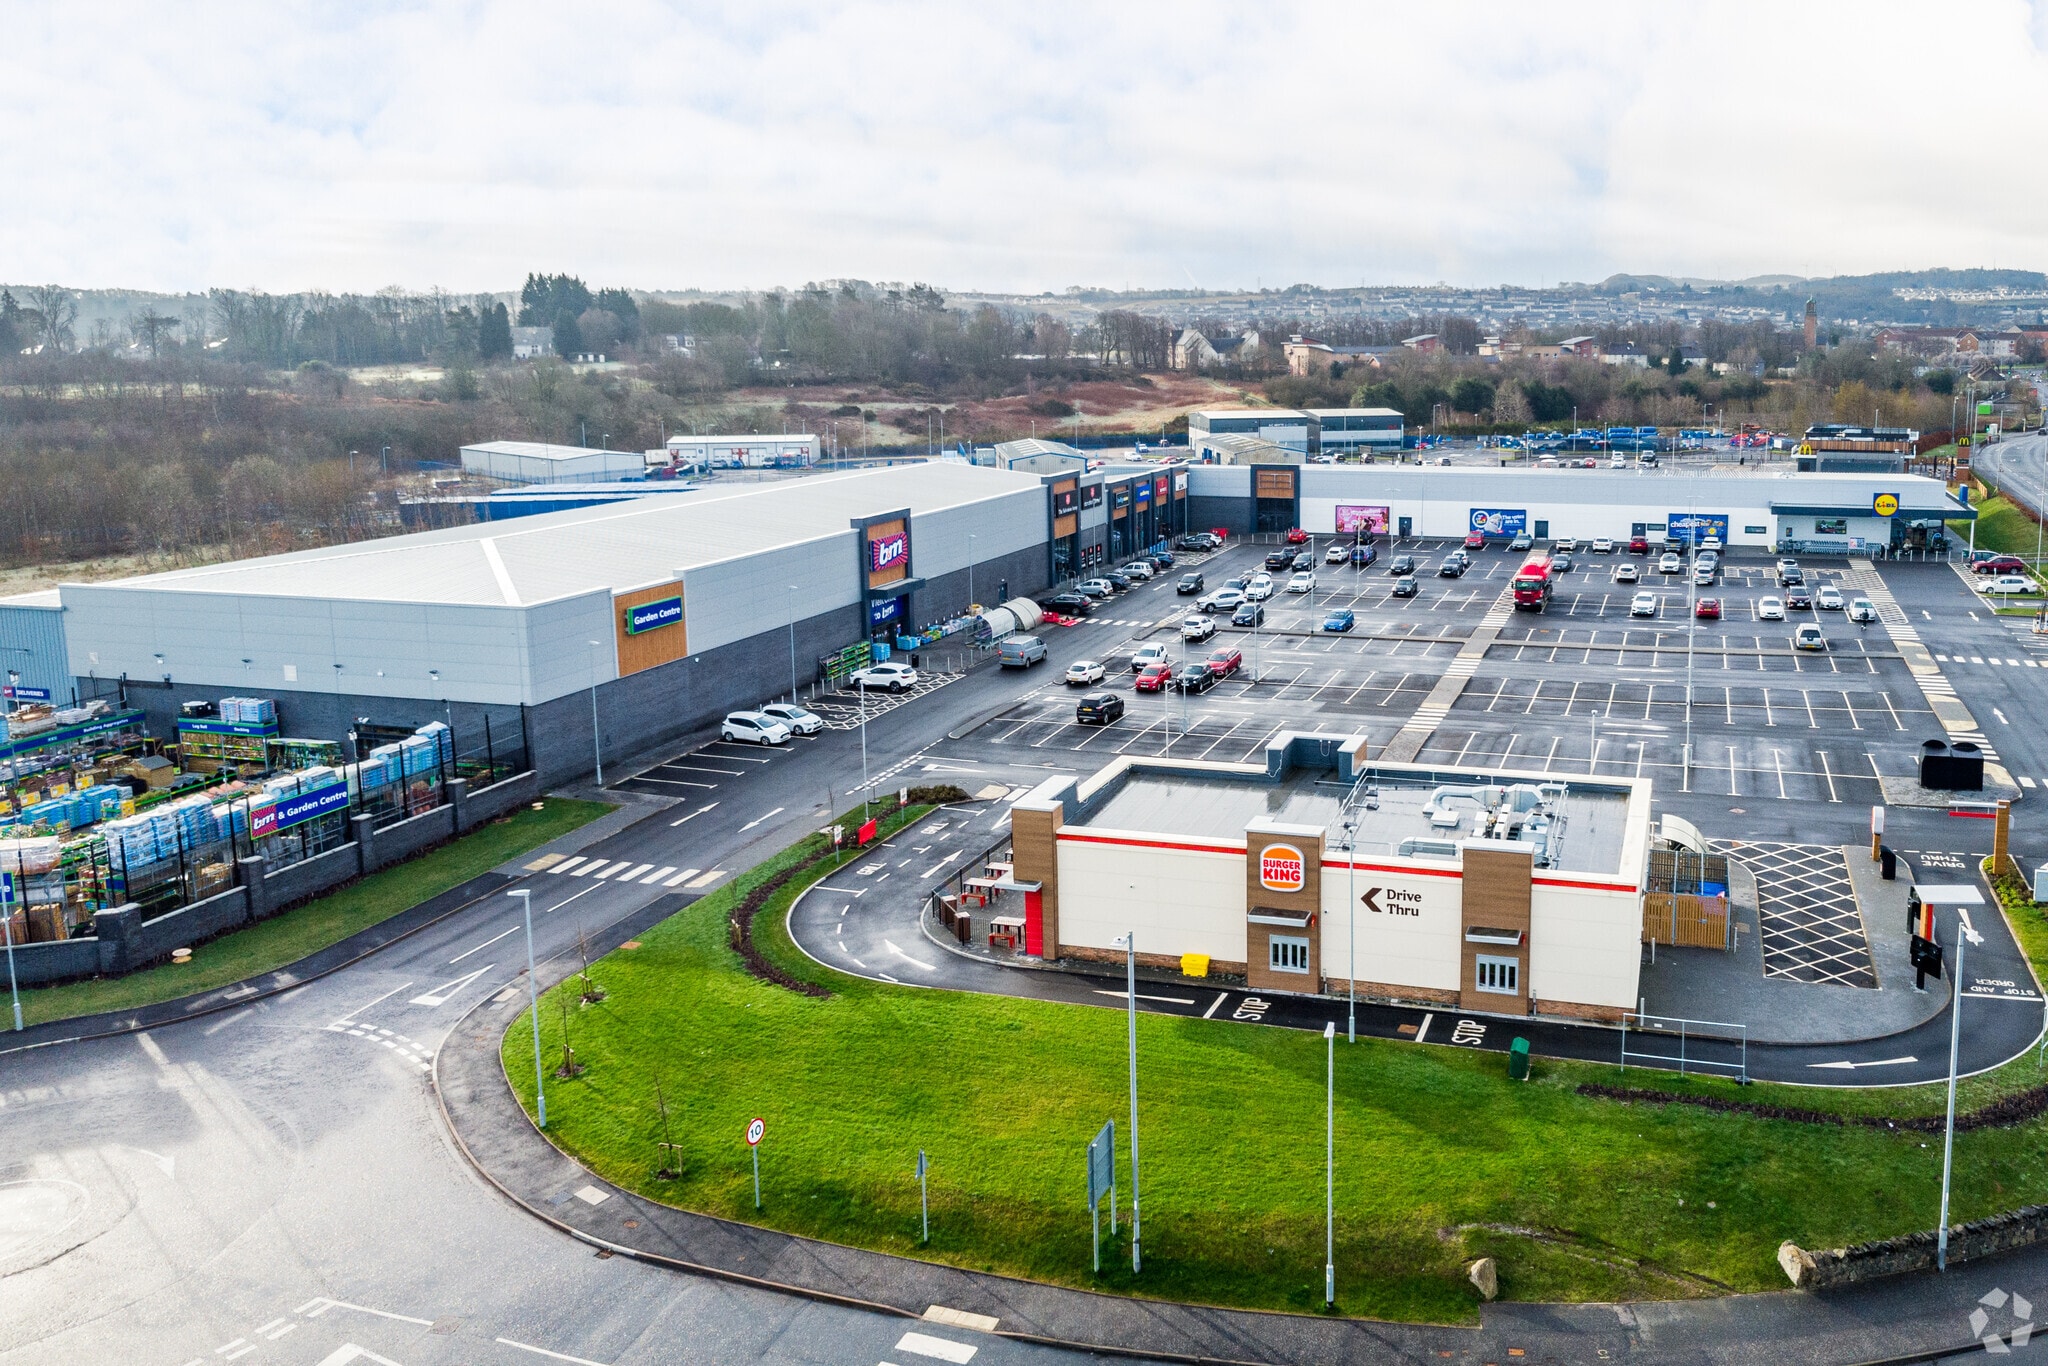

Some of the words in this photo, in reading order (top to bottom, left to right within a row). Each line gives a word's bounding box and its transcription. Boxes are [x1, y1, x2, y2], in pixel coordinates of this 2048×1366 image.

[634, 613, 659, 625] Garden
[659, 607, 681, 618] Centre
[278, 812, 285, 820] &
[287, 801, 318, 817] Garden
[319, 791, 347, 805] Centre
[1263, 859, 1301, 870] BURGER
[1920, 854, 1960, 862] THRU
[1921, 860, 1966, 869] DRIVE
[1263, 868, 1301, 882] KING
[1386, 889, 1422, 902] Drive
[1386, 903, 1419, 917] Thru
[1975, 978, 2016, 988] ORDER
[1233, 997, 1271, 1021] STOP
[1451, 1019, 1487, 1045] STOP
[750, 1124, 762, 1139] 10
